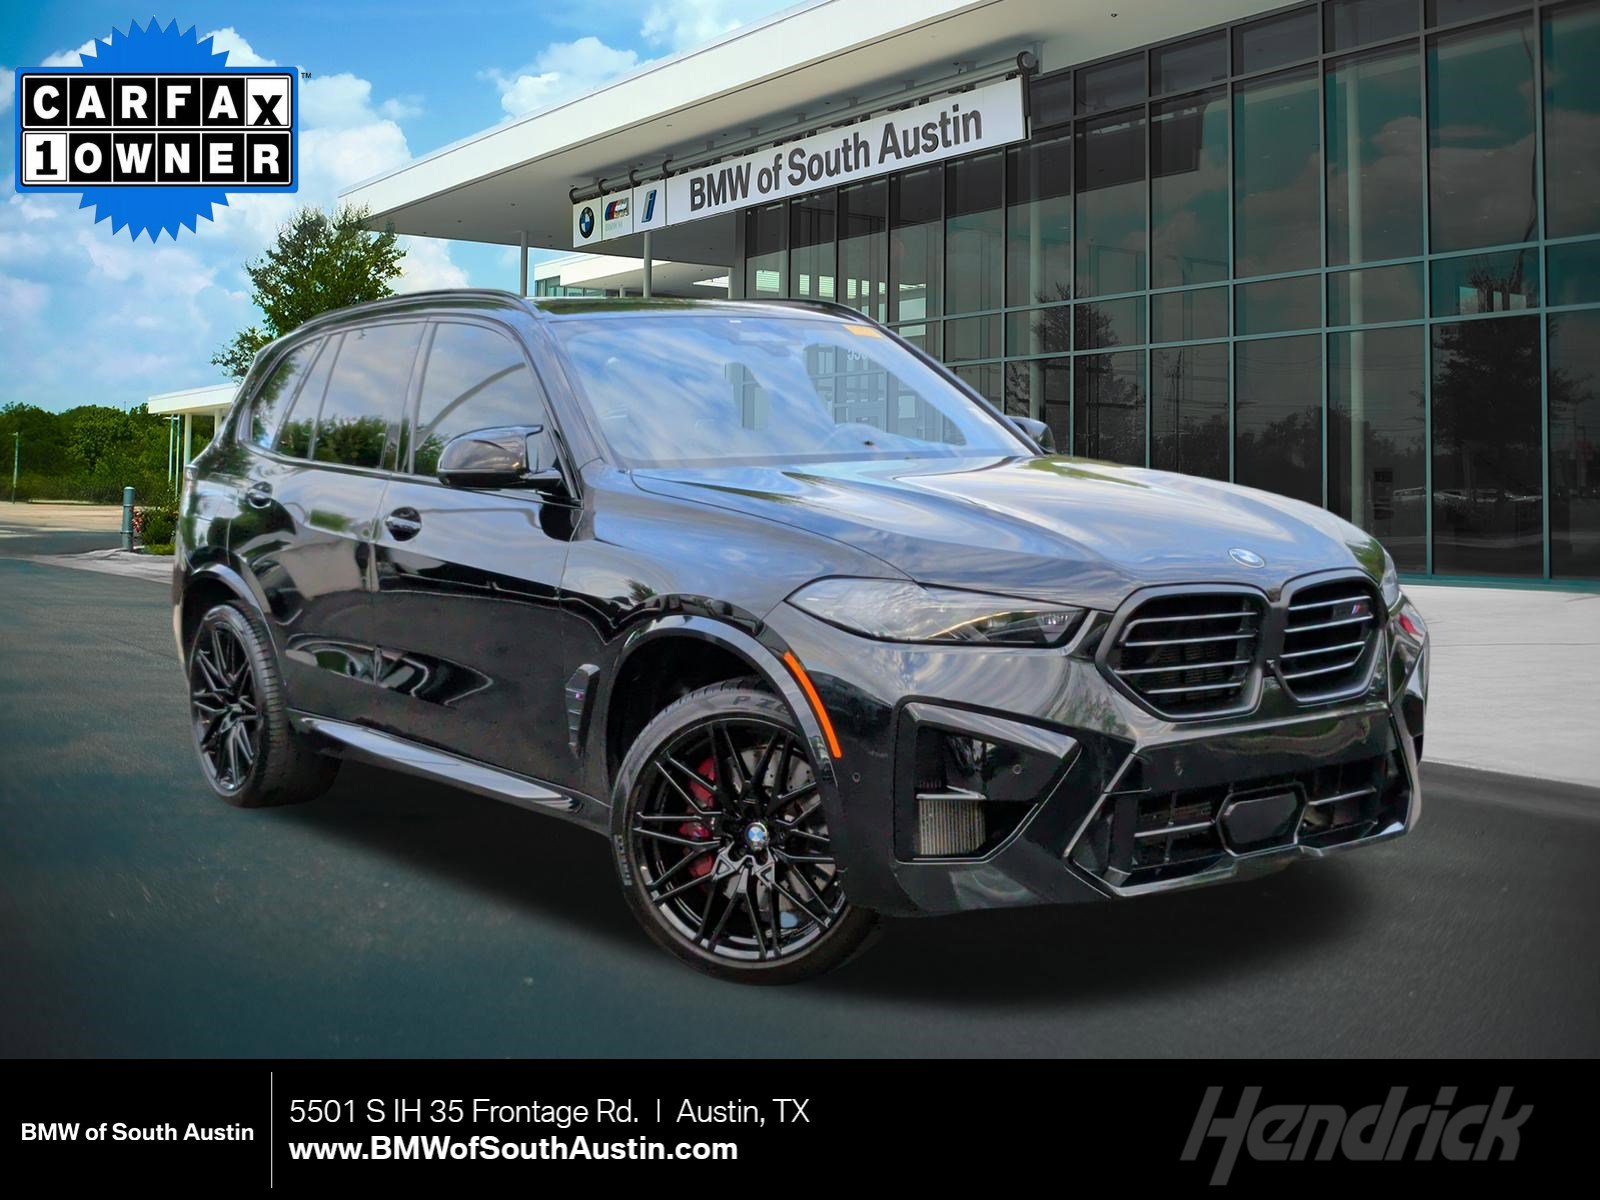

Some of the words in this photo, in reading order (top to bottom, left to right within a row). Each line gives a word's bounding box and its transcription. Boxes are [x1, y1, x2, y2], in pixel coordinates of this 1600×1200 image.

[690, 162, 751, 212] BMW
[757, 153, 783, 195] of
[787, 131, 871, 186] South
[878, 103, 982, 164] Austin
